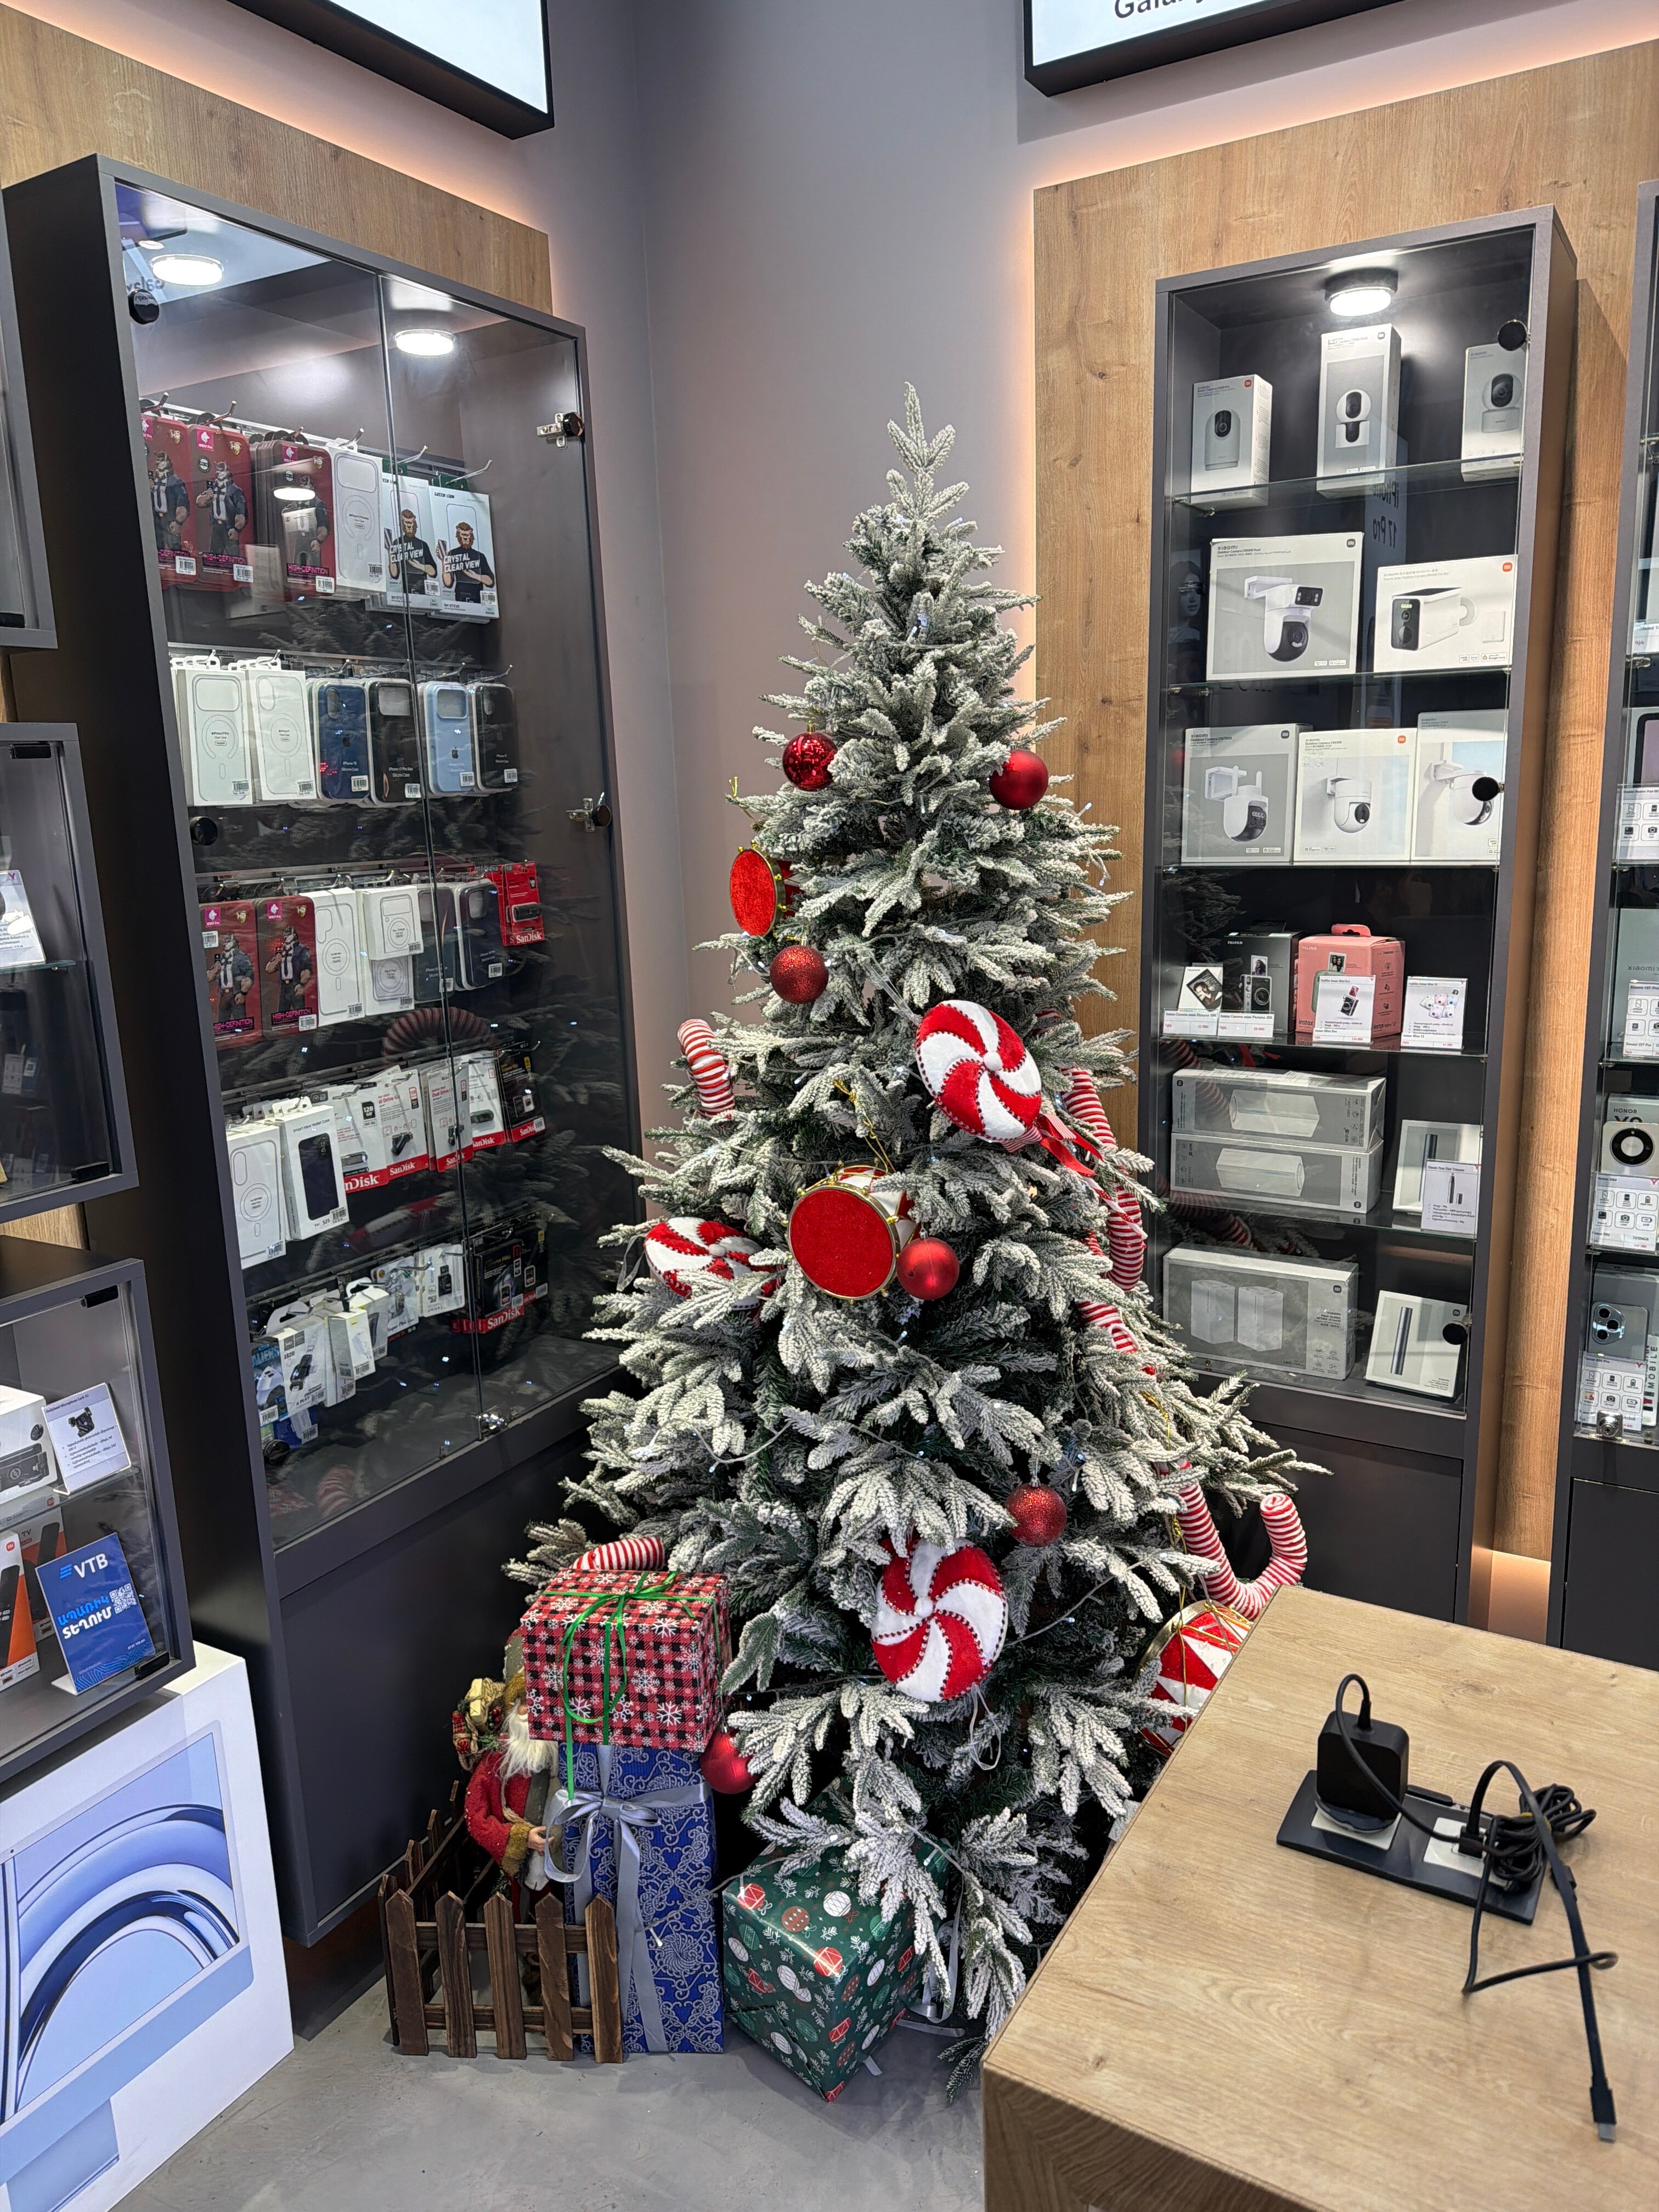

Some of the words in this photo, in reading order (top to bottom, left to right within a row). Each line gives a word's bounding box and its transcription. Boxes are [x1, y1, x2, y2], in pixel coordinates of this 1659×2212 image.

[410, 549, 424, 560] VIEW
[443, 553, 471, 565] CRYSTAL
[287, 563, 328, 575] HIGH-DEFINITION
[444, 563, 464, 573] CLEAR
[465, 559, 481, 569] VIEW
[297, 906, 307, 915] HD
[516, 931, 542, 944] SanDisk
[272, 1008, 311, 1020] HIGH-DEFINITION
[1299, 1018, 1313, 1026] instax
[363, 1105, 374, 1113] 128
[520, 1126, 534, 1136] SanDis
[446, 1152, 465, 1166] Sank
[389, 1161, 416, 1176] SanDisk
[345, 1174, 380, 1192] nDisk
[487, 1307, 522, 1329] SanDisk
[1647, 1346, 1658, 1389] MOBILE
[22, 1528, 31, 1537] TV
[74, 1553, 109, 1578] VTB
